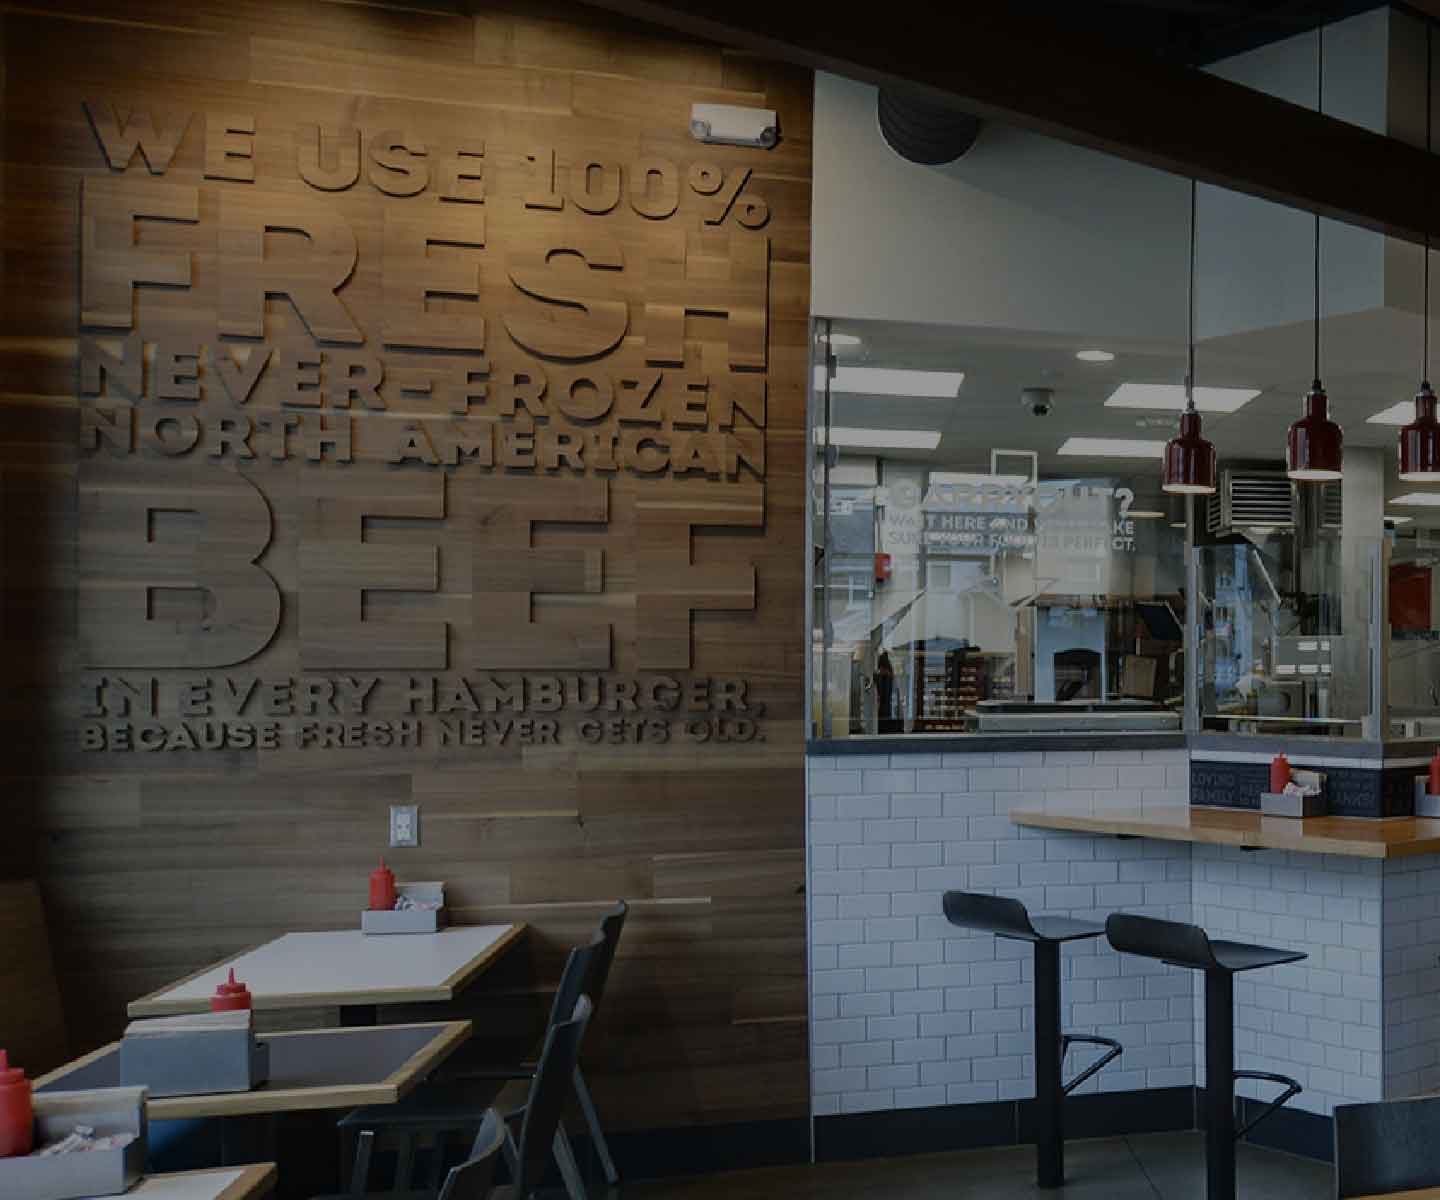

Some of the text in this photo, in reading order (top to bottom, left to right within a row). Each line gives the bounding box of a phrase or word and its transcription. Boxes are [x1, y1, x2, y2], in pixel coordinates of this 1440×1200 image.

[80, 101, 771, 231] WE USE 100%
[80, 176, 771, 373] FRESH
[79, 336, 768, 434] NEVER-FROZEN
[79, 405, 768, 482] NORTH AMERICAN
[942, 514, 985, 531] HERE
[78, 464, 768, 672] BEEF
[82, 718, 767, 752] BECAUSE FRESH NEVER GETS OLD.
[83, 676, 767, 718] IN EVERY HAMBURGER,
